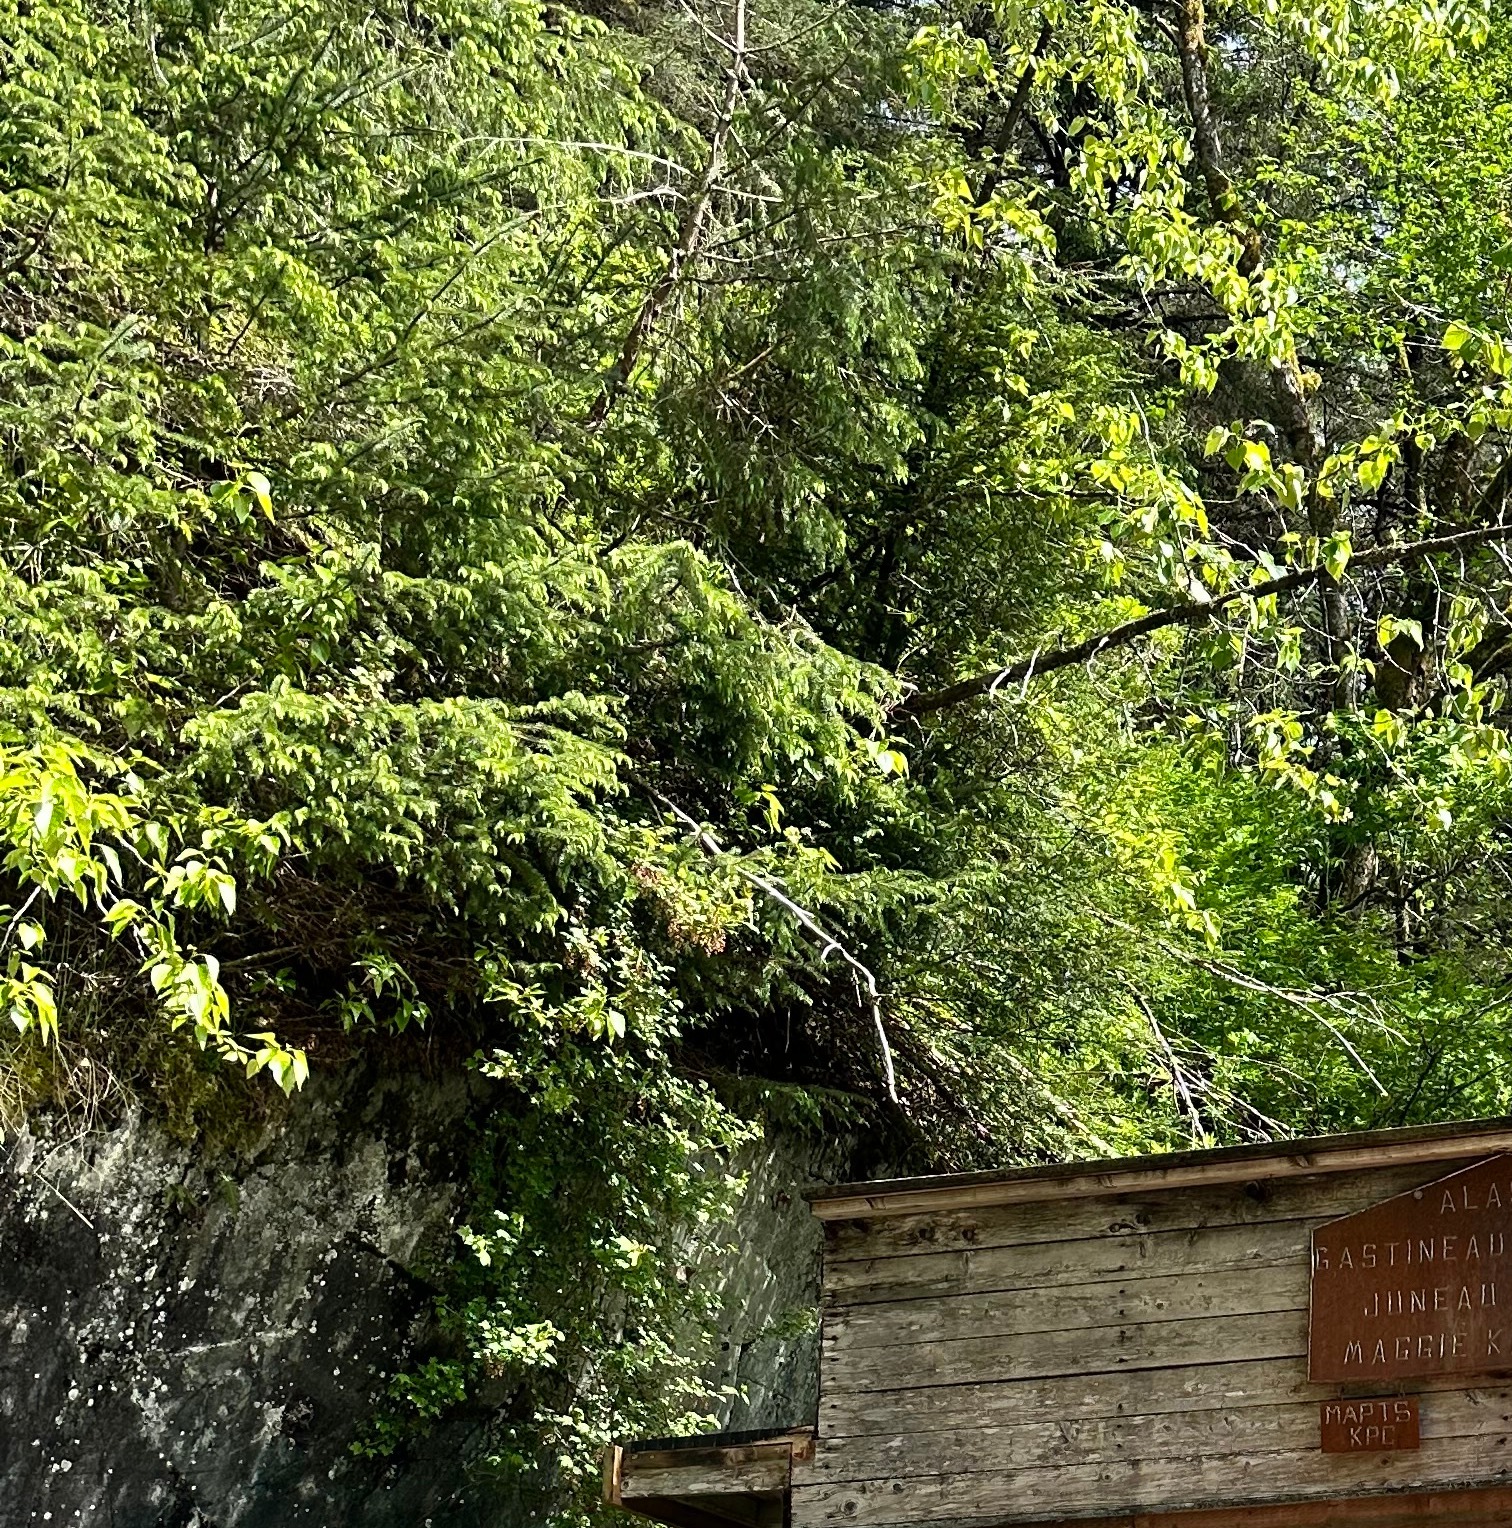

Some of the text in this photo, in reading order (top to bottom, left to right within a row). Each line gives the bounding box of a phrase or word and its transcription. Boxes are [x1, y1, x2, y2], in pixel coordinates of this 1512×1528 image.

[1316, 1232, 1504, 1270] GASTINEAU
[1364, 1282, 1496, 1318] JUNEAU
[1343, 1332, 1467, 1365] MAGGIE
[1325, 1401, 1411, 1425] MAPTS
[1350, 1425, 1395, 1448] KPC
